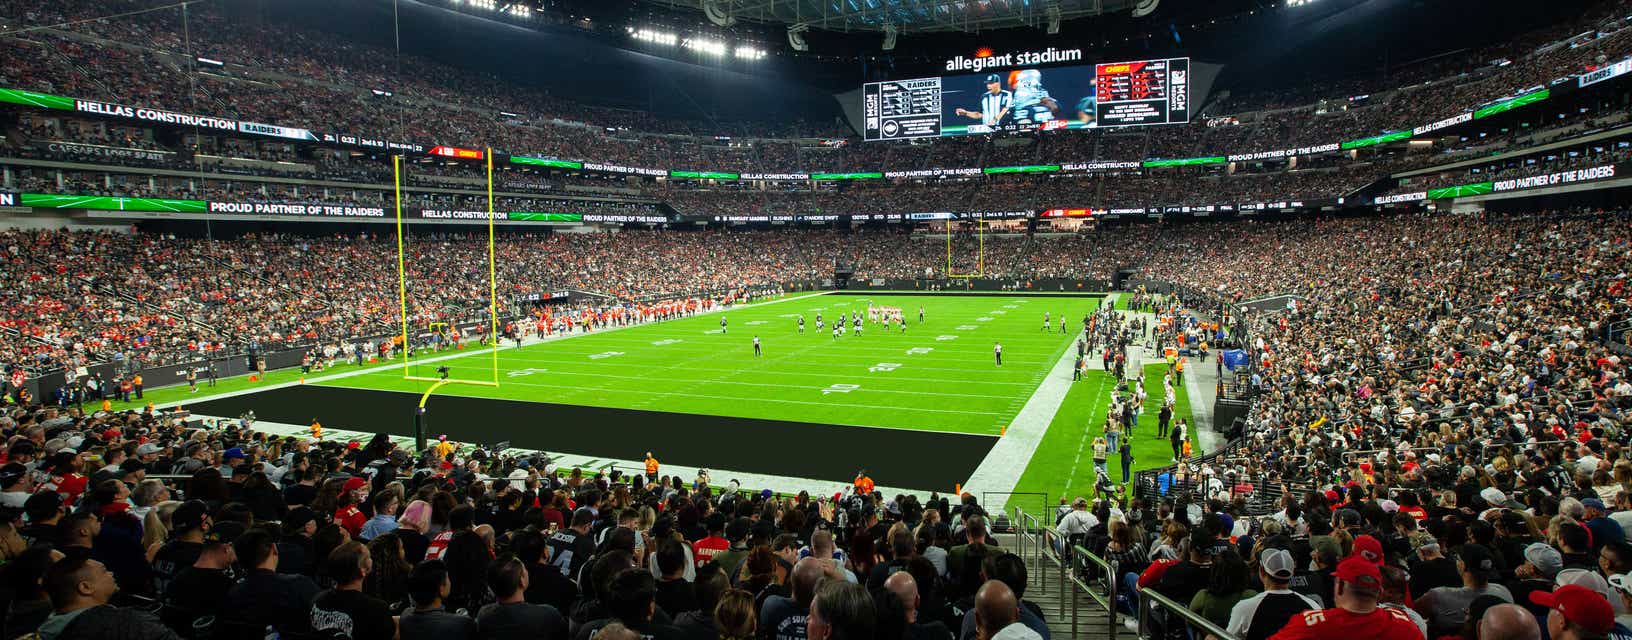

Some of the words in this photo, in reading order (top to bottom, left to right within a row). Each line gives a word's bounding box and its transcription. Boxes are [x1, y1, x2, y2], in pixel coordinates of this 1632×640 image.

[946, 53, 1012, 72] allegiant
[1016, 47, 1082, 65] stadium
[907, 80, 937, 88] RAIDERS
[1176, 85, 1186, 111] MGM
[866, 93, 874, 117] MGM
[76, 100, 134, 117] HELLAS
[135, 108, 236, 131] CONSTRUCTION
[243, 124, 282, 135] RAIDERS
[1413, 124, 1431, 136] HELLAS
[1432, 112, 1473, 130] CONSTRUCTION
[341, 136, 356, 144] 0:32
[48, 143, 101, 155] CAESARS
[1254, 150, 1285, 159] PARTNER
[1286, 148, 1296, 156] OF
[1312, 143, 1340, 152] RAIDERS
[604, 165, 627, 173] PARTNER
[646, 168, 668, 176] RAIDERS
[1493, 180, 1516, 192] PROUD
[1516, 174, 1548, 188] PARTNER
[1550, 172, 1561, 184] OF
[1561, 170, 1576, 182] THE
[1578, 164, 1615, 180] RAIDERS
[0, 194, 13, 206] N
[1375, 195, 1391, 204] HELLAS
[1392, 192, 1427, 202] CONSTRUCTION
[210, 202, 252, 213] PROUD
[255, 203, 306, 214] PARTNER
[307, 205, 322, 215] OF
[324, 206, 343, 216] THE
[344, 206, 384, 217] RAIDERS
[422, 210, 452, 218] HELLAS
[452, 210, 508, 220] CONSTRUCTION
